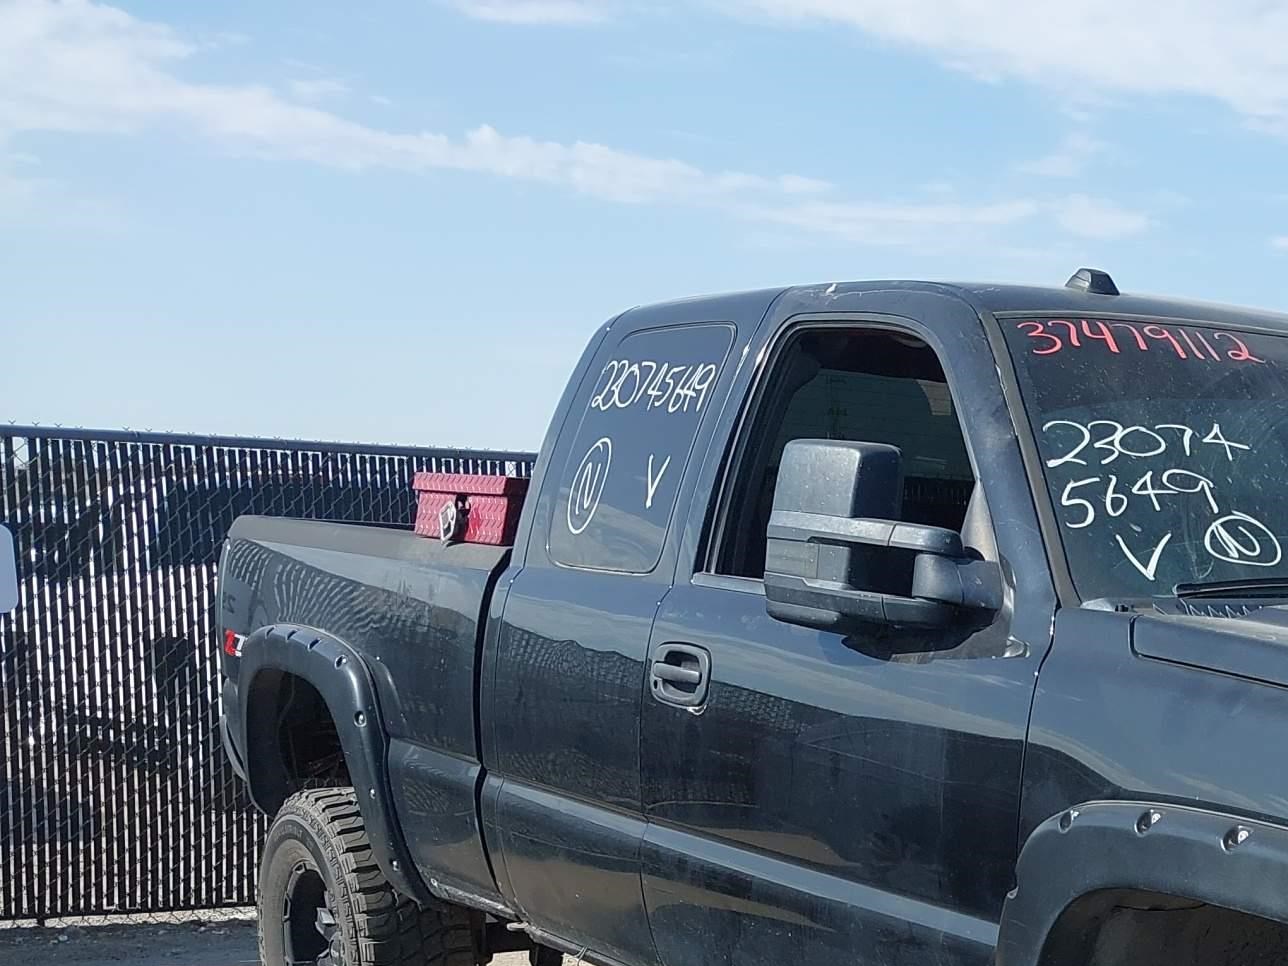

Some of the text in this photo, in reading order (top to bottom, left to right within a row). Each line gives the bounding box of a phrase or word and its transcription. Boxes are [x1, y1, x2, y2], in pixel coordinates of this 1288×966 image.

[1017, 320, 1266, 364] 37479112
[1043, 420, 1250, 468] 23074
[645, 454, 671, 509] V
[1061, 468, 1220, 528] 5649
[1115, 532, 1172, 581] V
